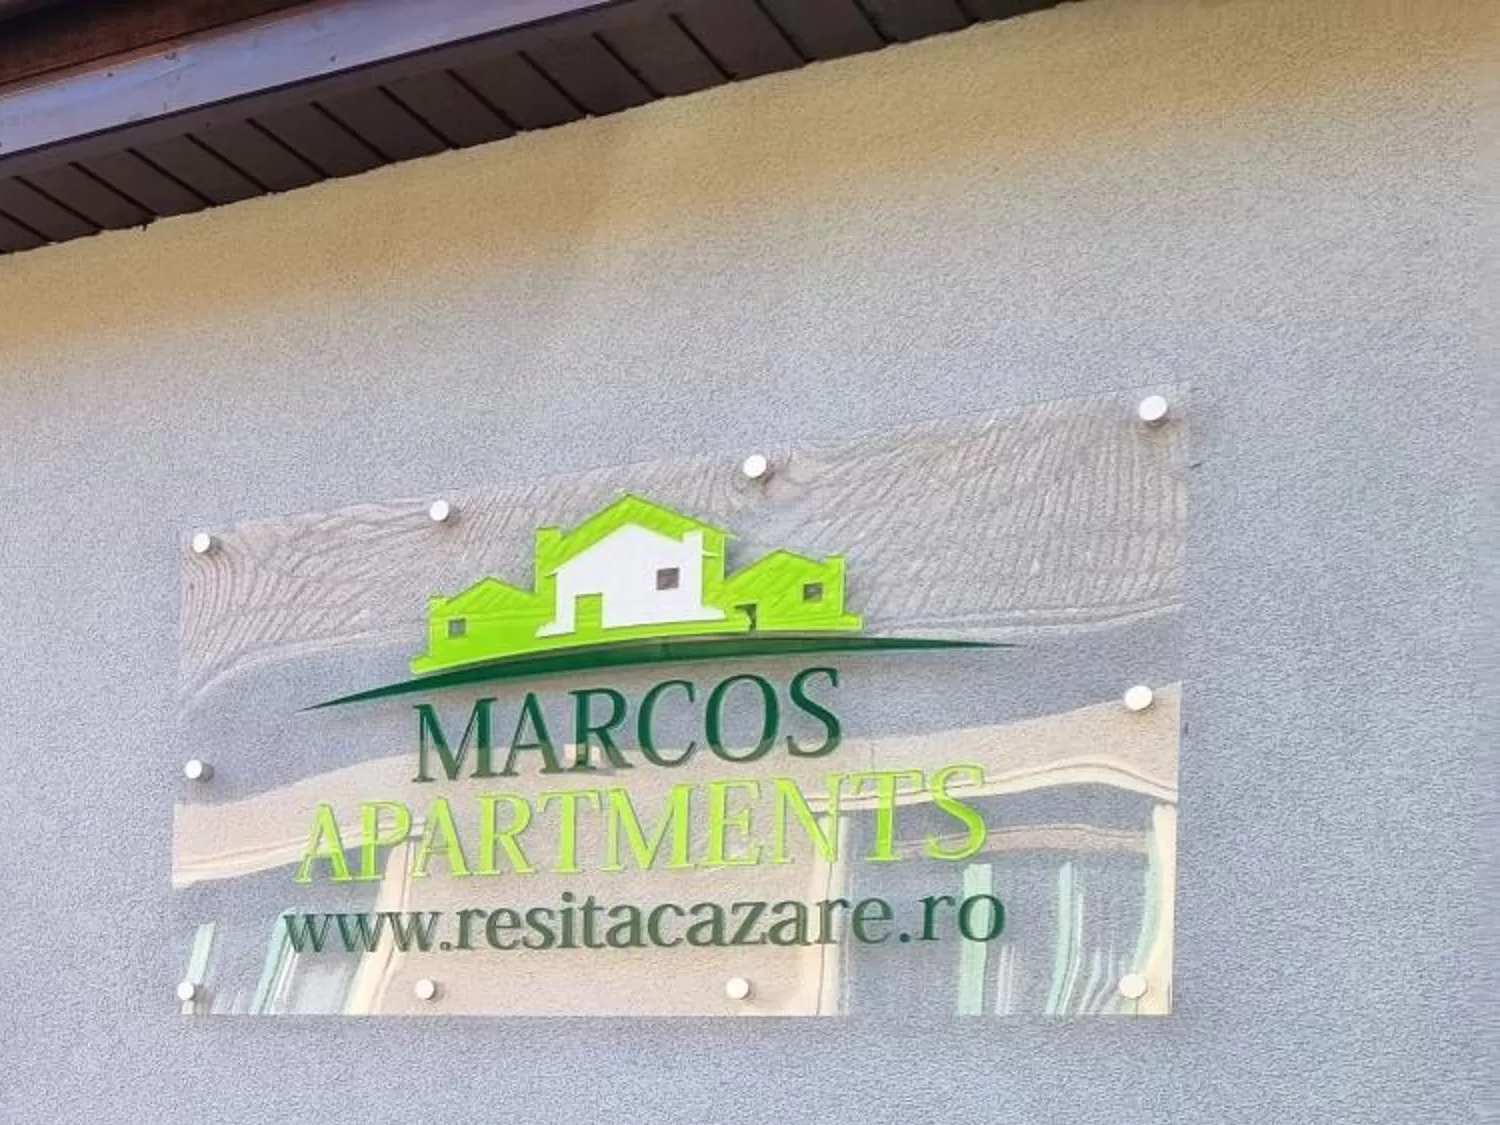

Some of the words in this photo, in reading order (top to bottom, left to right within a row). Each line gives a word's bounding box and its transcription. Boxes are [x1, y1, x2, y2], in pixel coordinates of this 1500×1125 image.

[412, 666, 842, 783] MARCOS
[296, 764, 990, 883] APARTMENTS
[283, 891, 1006, 954] www.resitacazare.ro
